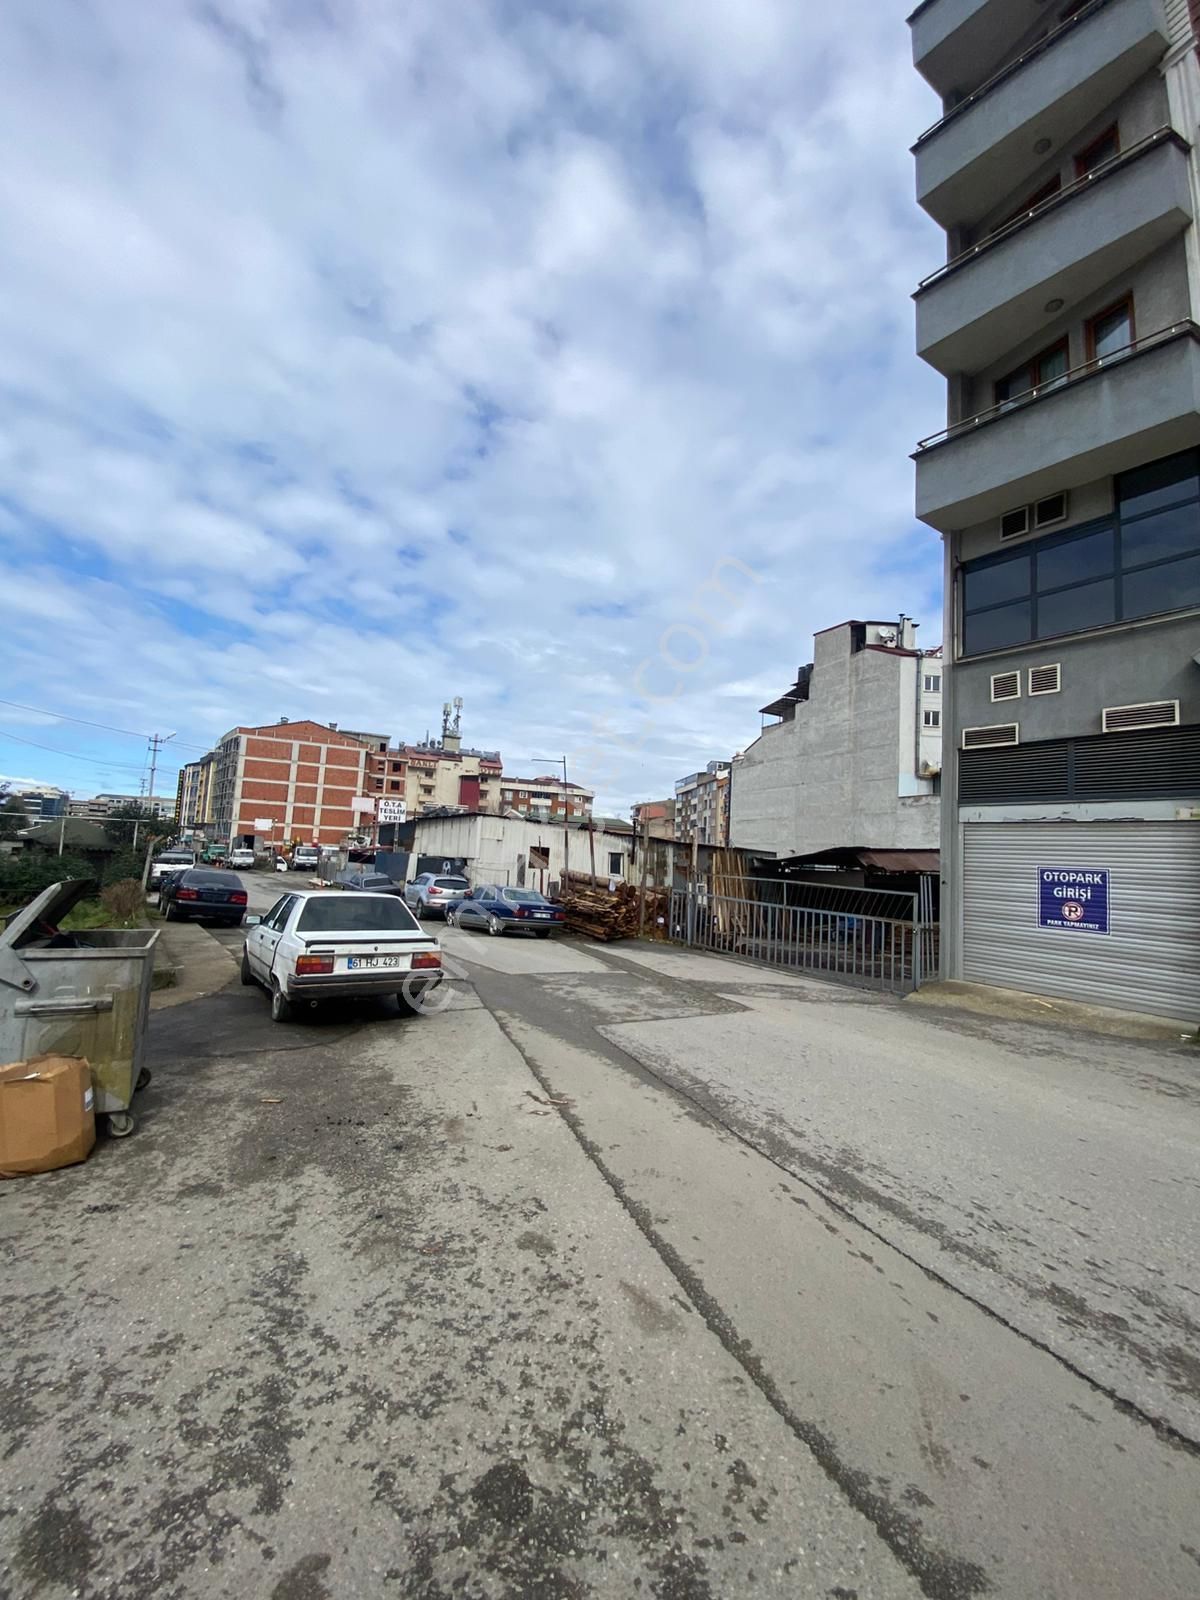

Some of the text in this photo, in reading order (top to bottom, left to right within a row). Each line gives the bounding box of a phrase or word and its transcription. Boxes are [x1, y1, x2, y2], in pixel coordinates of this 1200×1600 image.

[1043, 871, 1103, 884] OTOPARK
[1053, 885, 1091, 901] GİRİŞİ
[352, 957, 398, 968] 61 HJ 423
